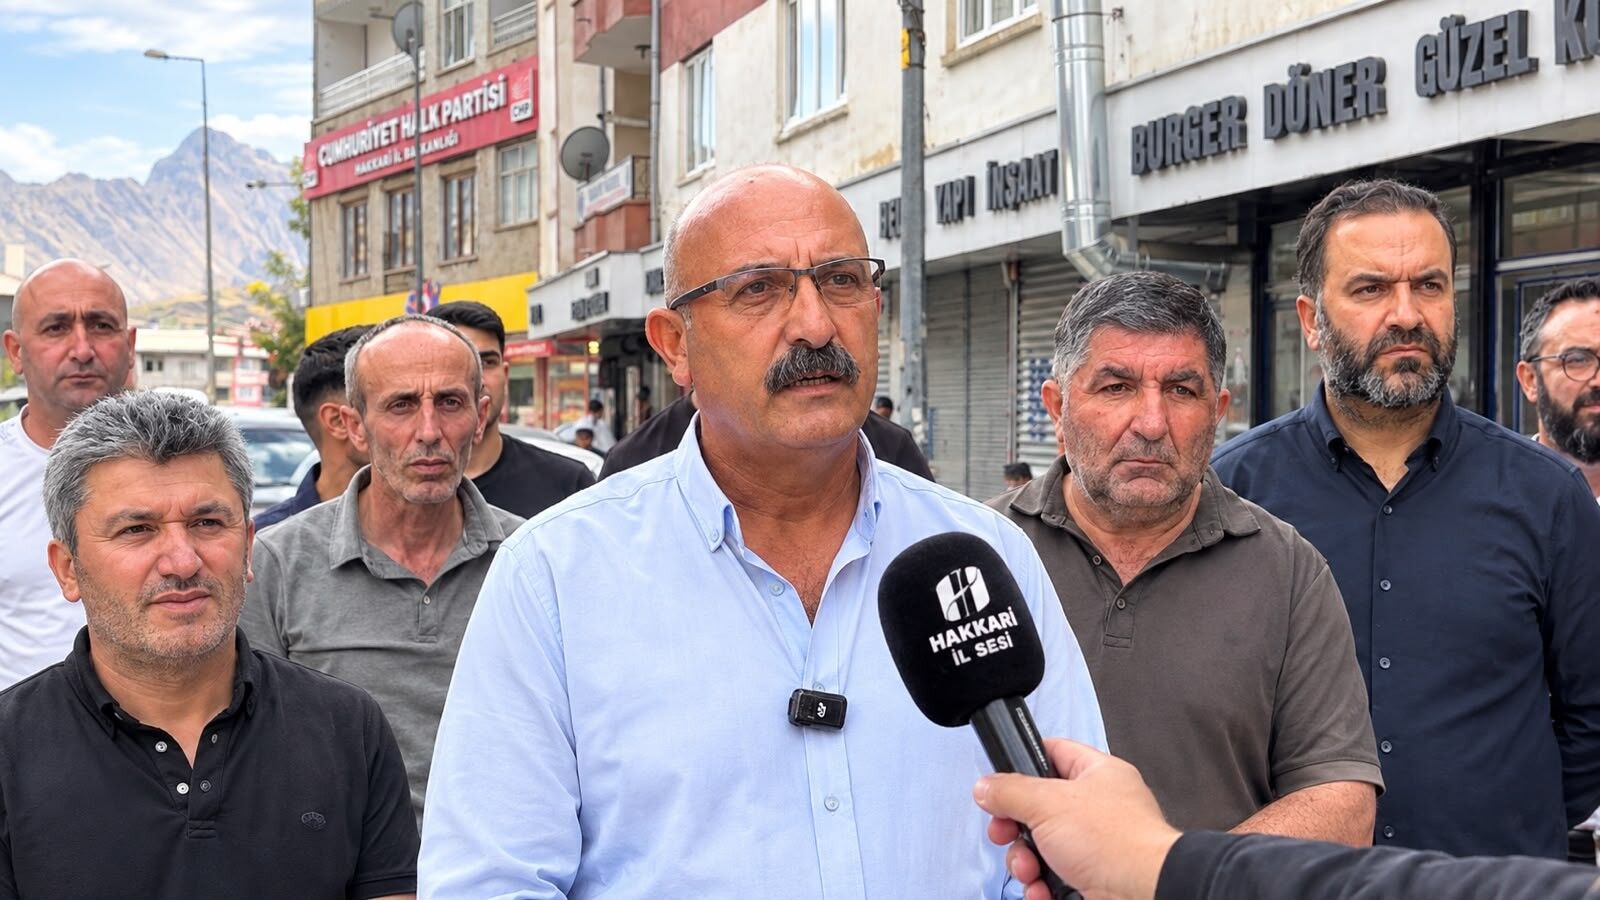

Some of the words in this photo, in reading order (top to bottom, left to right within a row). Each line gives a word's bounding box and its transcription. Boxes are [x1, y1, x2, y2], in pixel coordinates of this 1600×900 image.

[441, 73, 507, 125] PARTİSİ
[512, 101, 530, 118] CHP
[1131, 96, 1247, 176] BURGER
[1264, 56, 1387, 140] DÖNER
[1415, 10, 1539, 98] GÜZEL
[403, 128, 459, 160] BAKANLIĞI
[935, 175, 975, 225] YAPI
[928, 605, 1018, 654] HAKKARİ
[951, 648, 972, 666] İL
[974, 631, 1014, 658] SESİ
